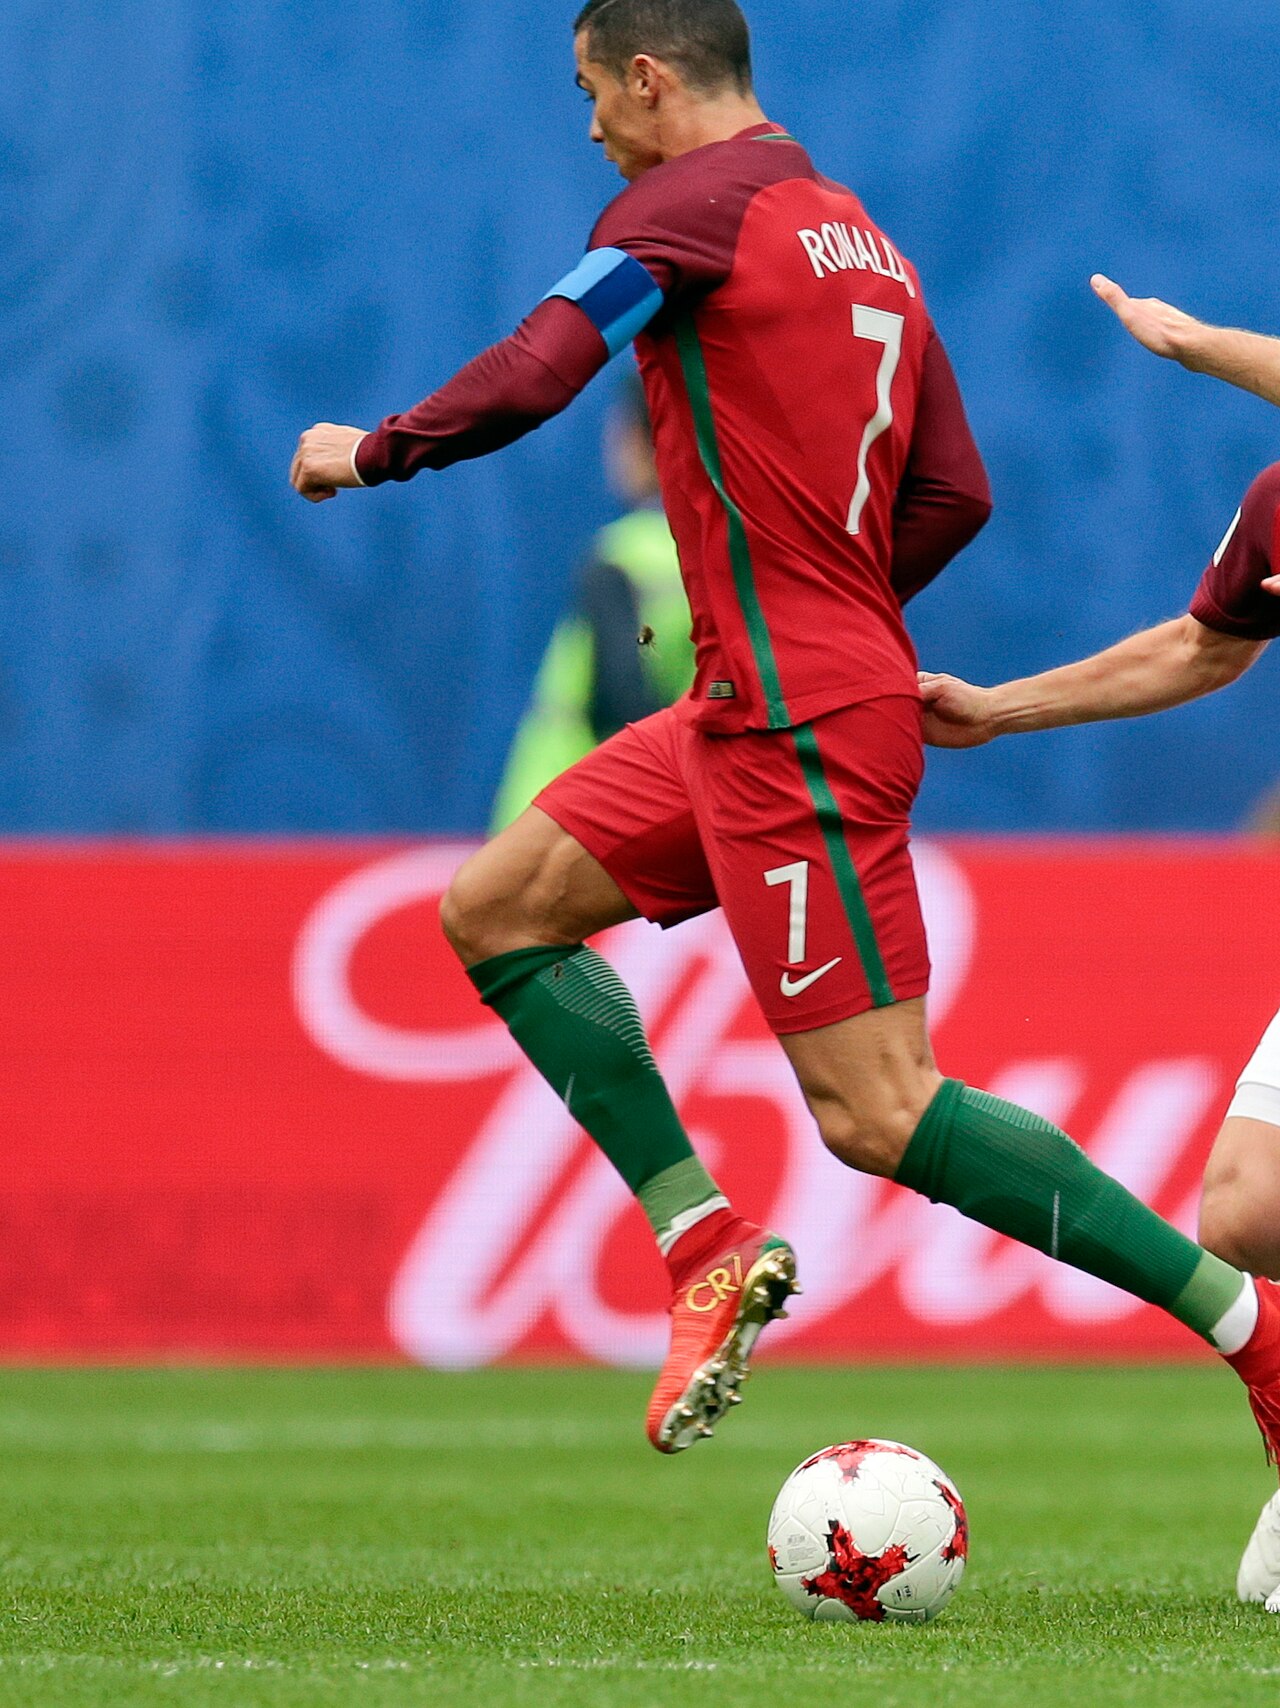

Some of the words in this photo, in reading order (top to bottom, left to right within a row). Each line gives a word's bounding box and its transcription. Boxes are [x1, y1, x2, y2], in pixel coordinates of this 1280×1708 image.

[846, 303, 905, 535] 7
[763, 860, 810, 966] 7
[685, 1252, 744, 1313] CR7
